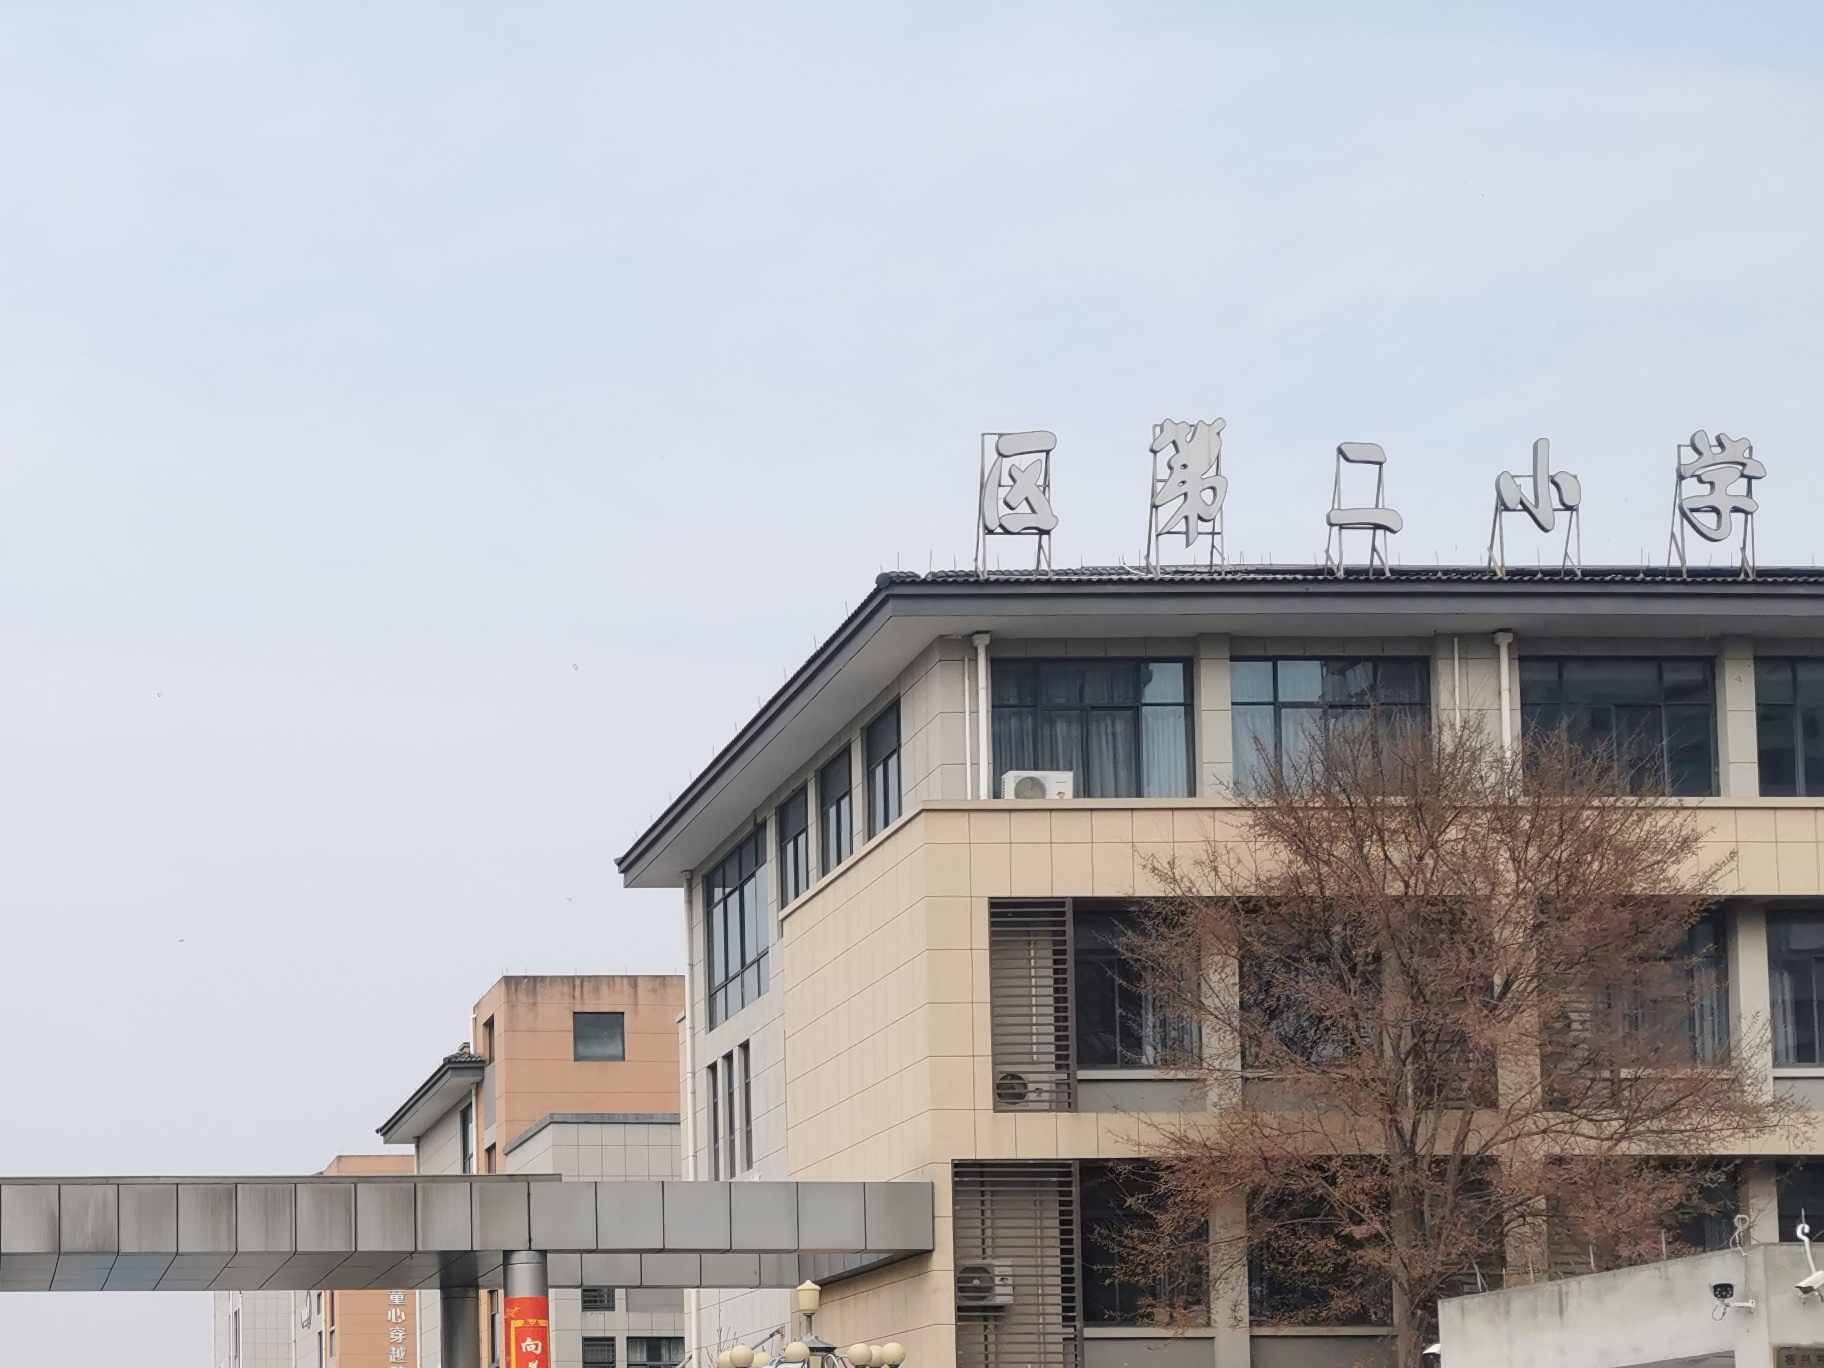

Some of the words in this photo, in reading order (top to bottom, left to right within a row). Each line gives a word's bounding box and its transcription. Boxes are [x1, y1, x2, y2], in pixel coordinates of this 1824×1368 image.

[983, 416, 1767, 548] 区第二小学
